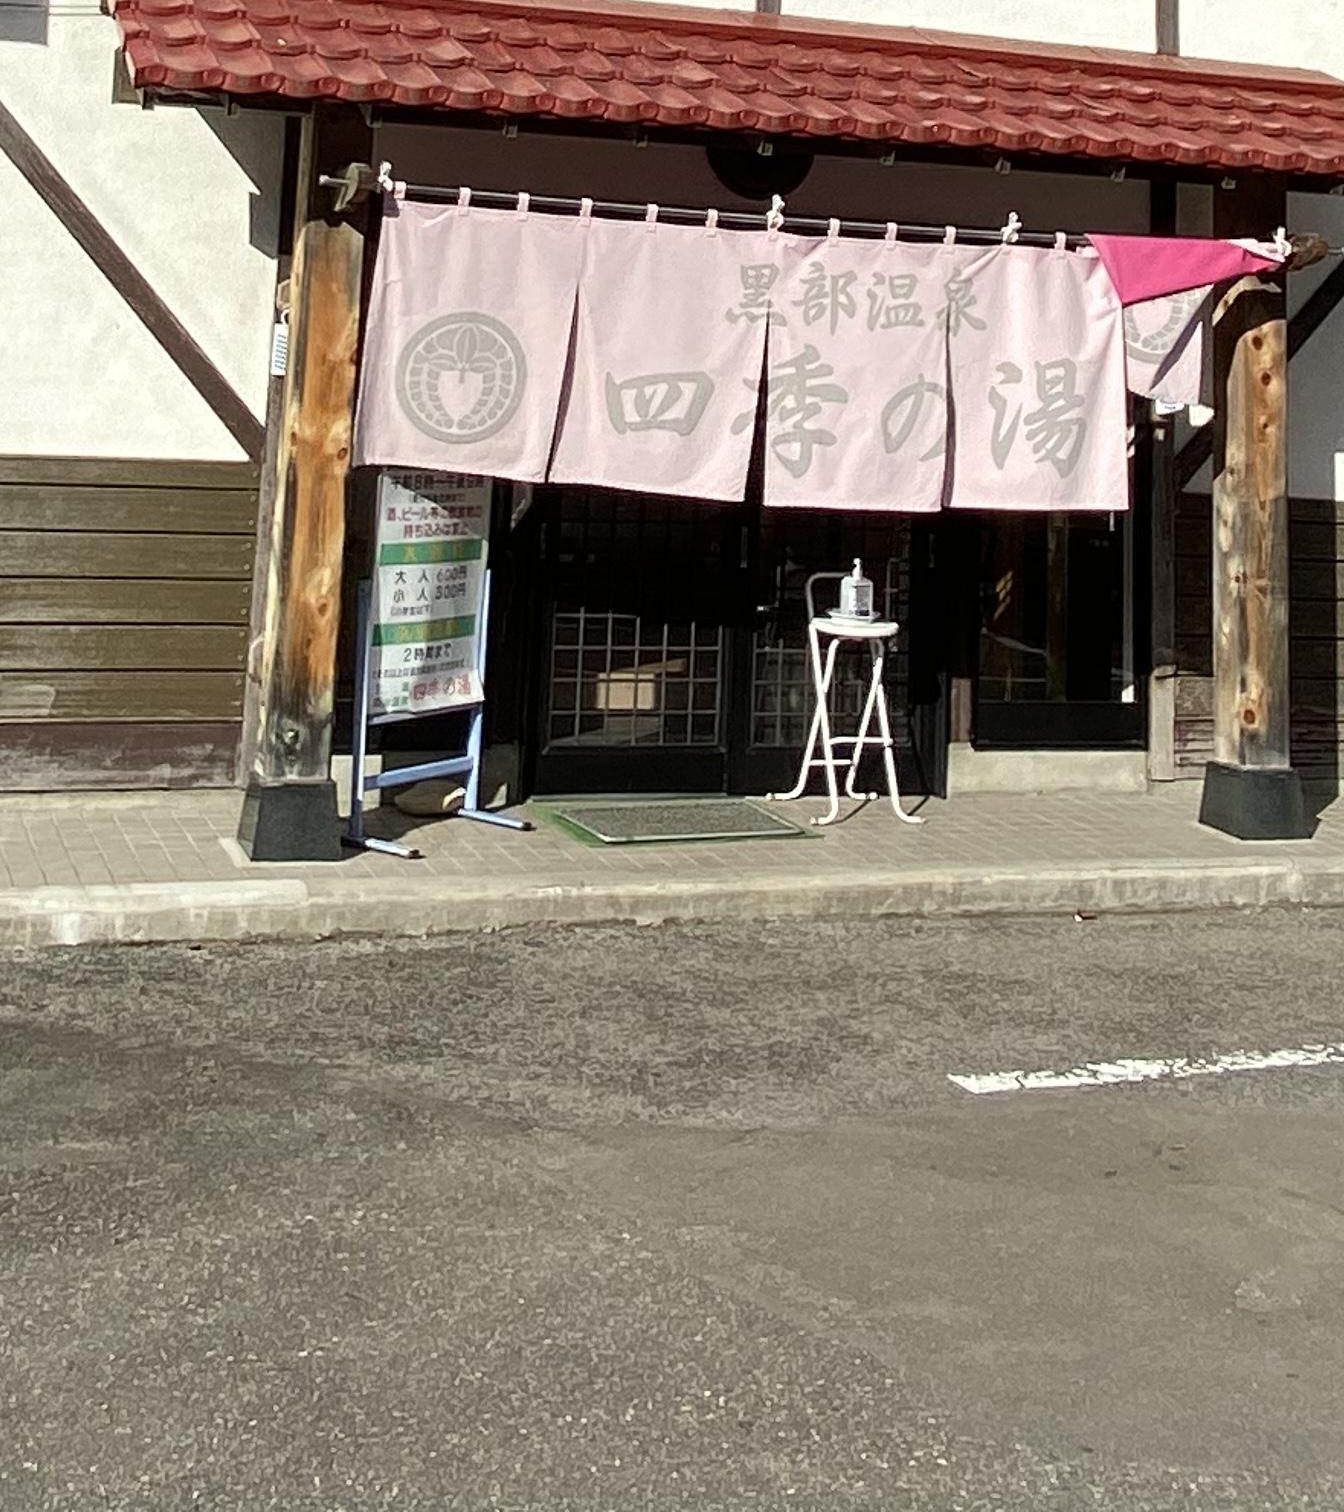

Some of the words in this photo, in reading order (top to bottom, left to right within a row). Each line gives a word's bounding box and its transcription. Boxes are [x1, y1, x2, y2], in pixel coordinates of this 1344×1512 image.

[725, 262, 987, 337] 黒部温泉
[604, 344, 1088, 480] 四季の湯
